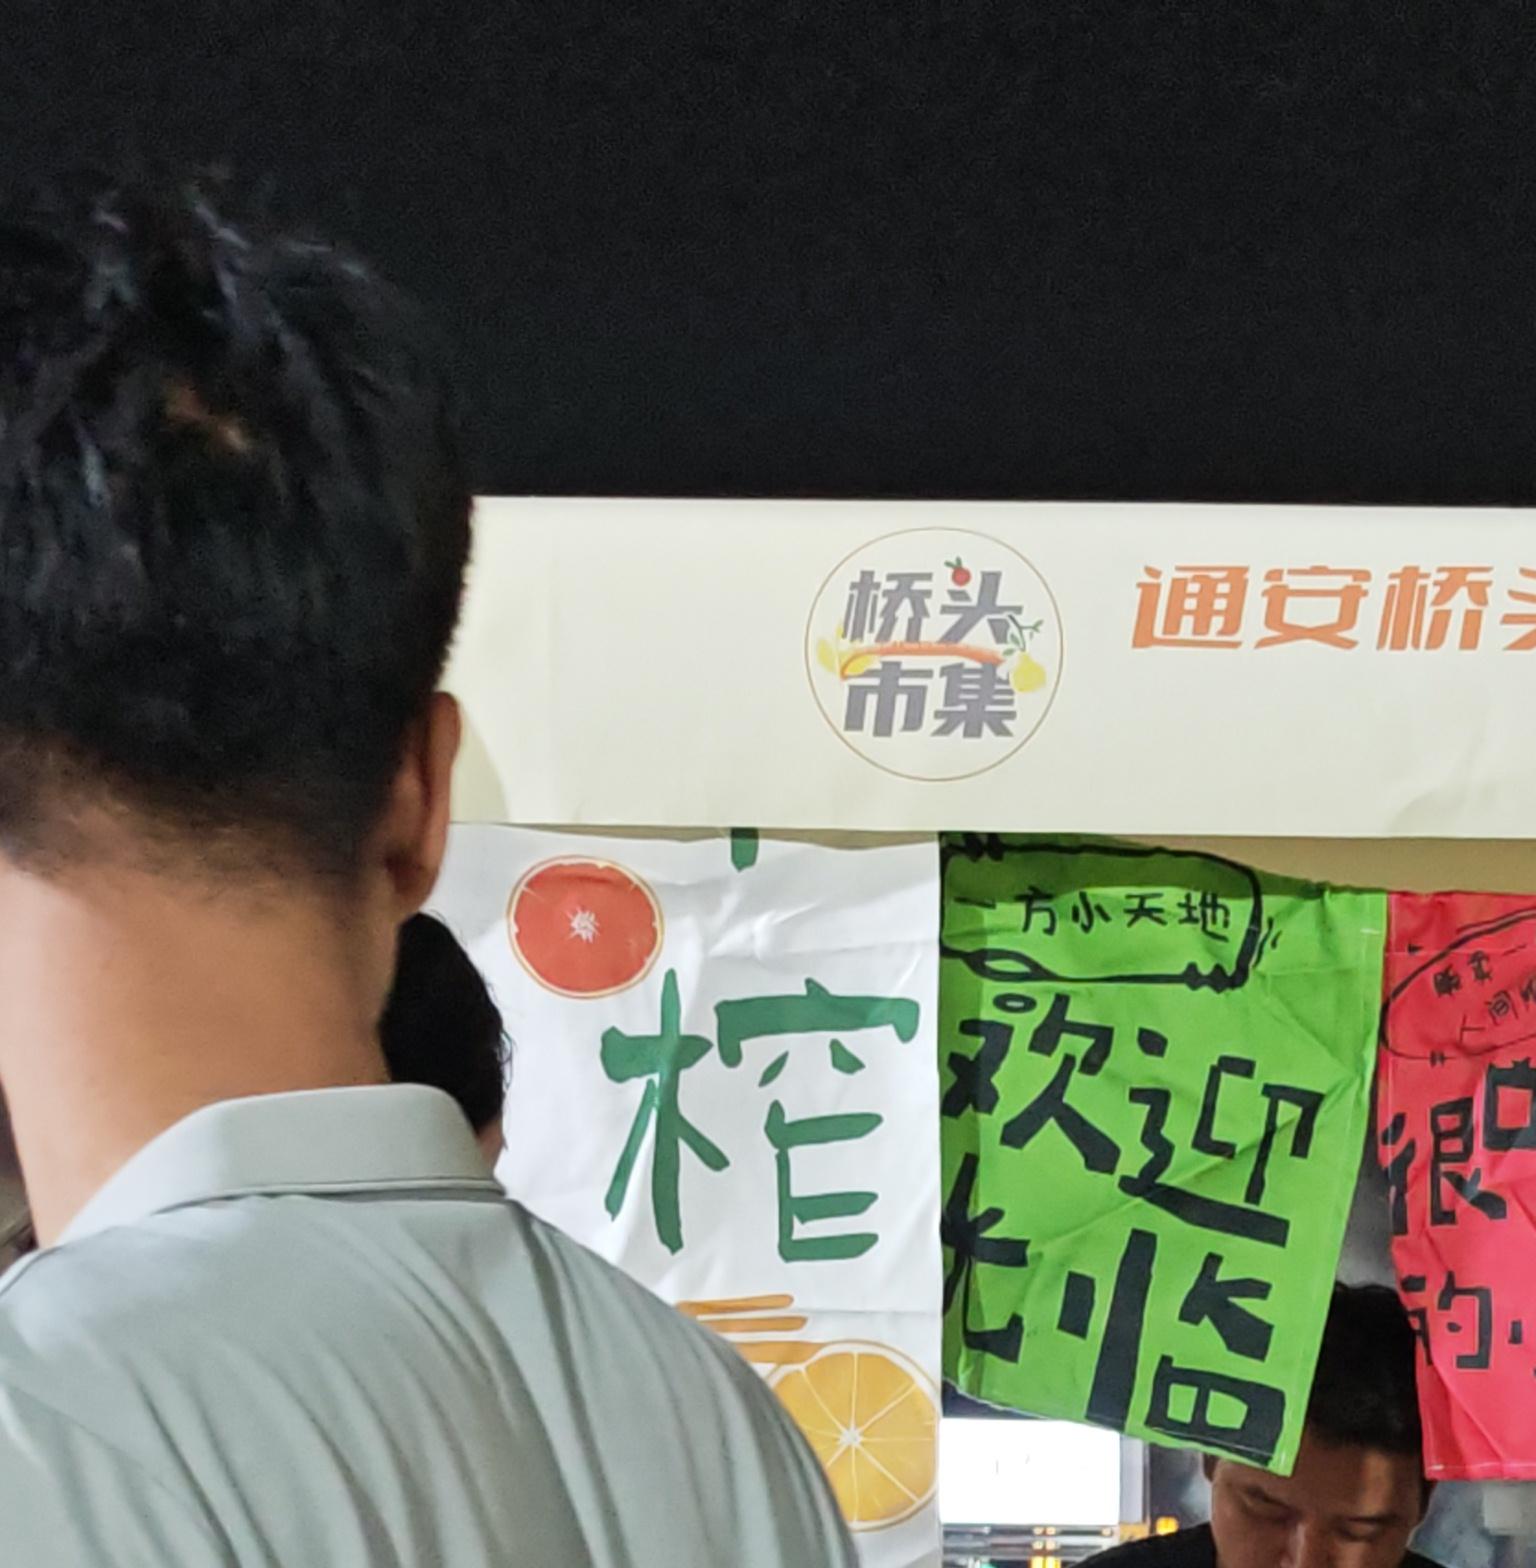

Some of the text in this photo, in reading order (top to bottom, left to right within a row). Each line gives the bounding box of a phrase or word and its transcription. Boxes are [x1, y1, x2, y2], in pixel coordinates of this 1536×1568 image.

[841, 571, 1024, 643] 桥头
[842, 661, 1018, 738] 市集
[953, 886, 1230, 942] 一方小天地
[600, 969, 920, 1263] 榨
[941, 992, 1326, 1248] 欢迎
[941, 1152, 1286, 1467] 光临
